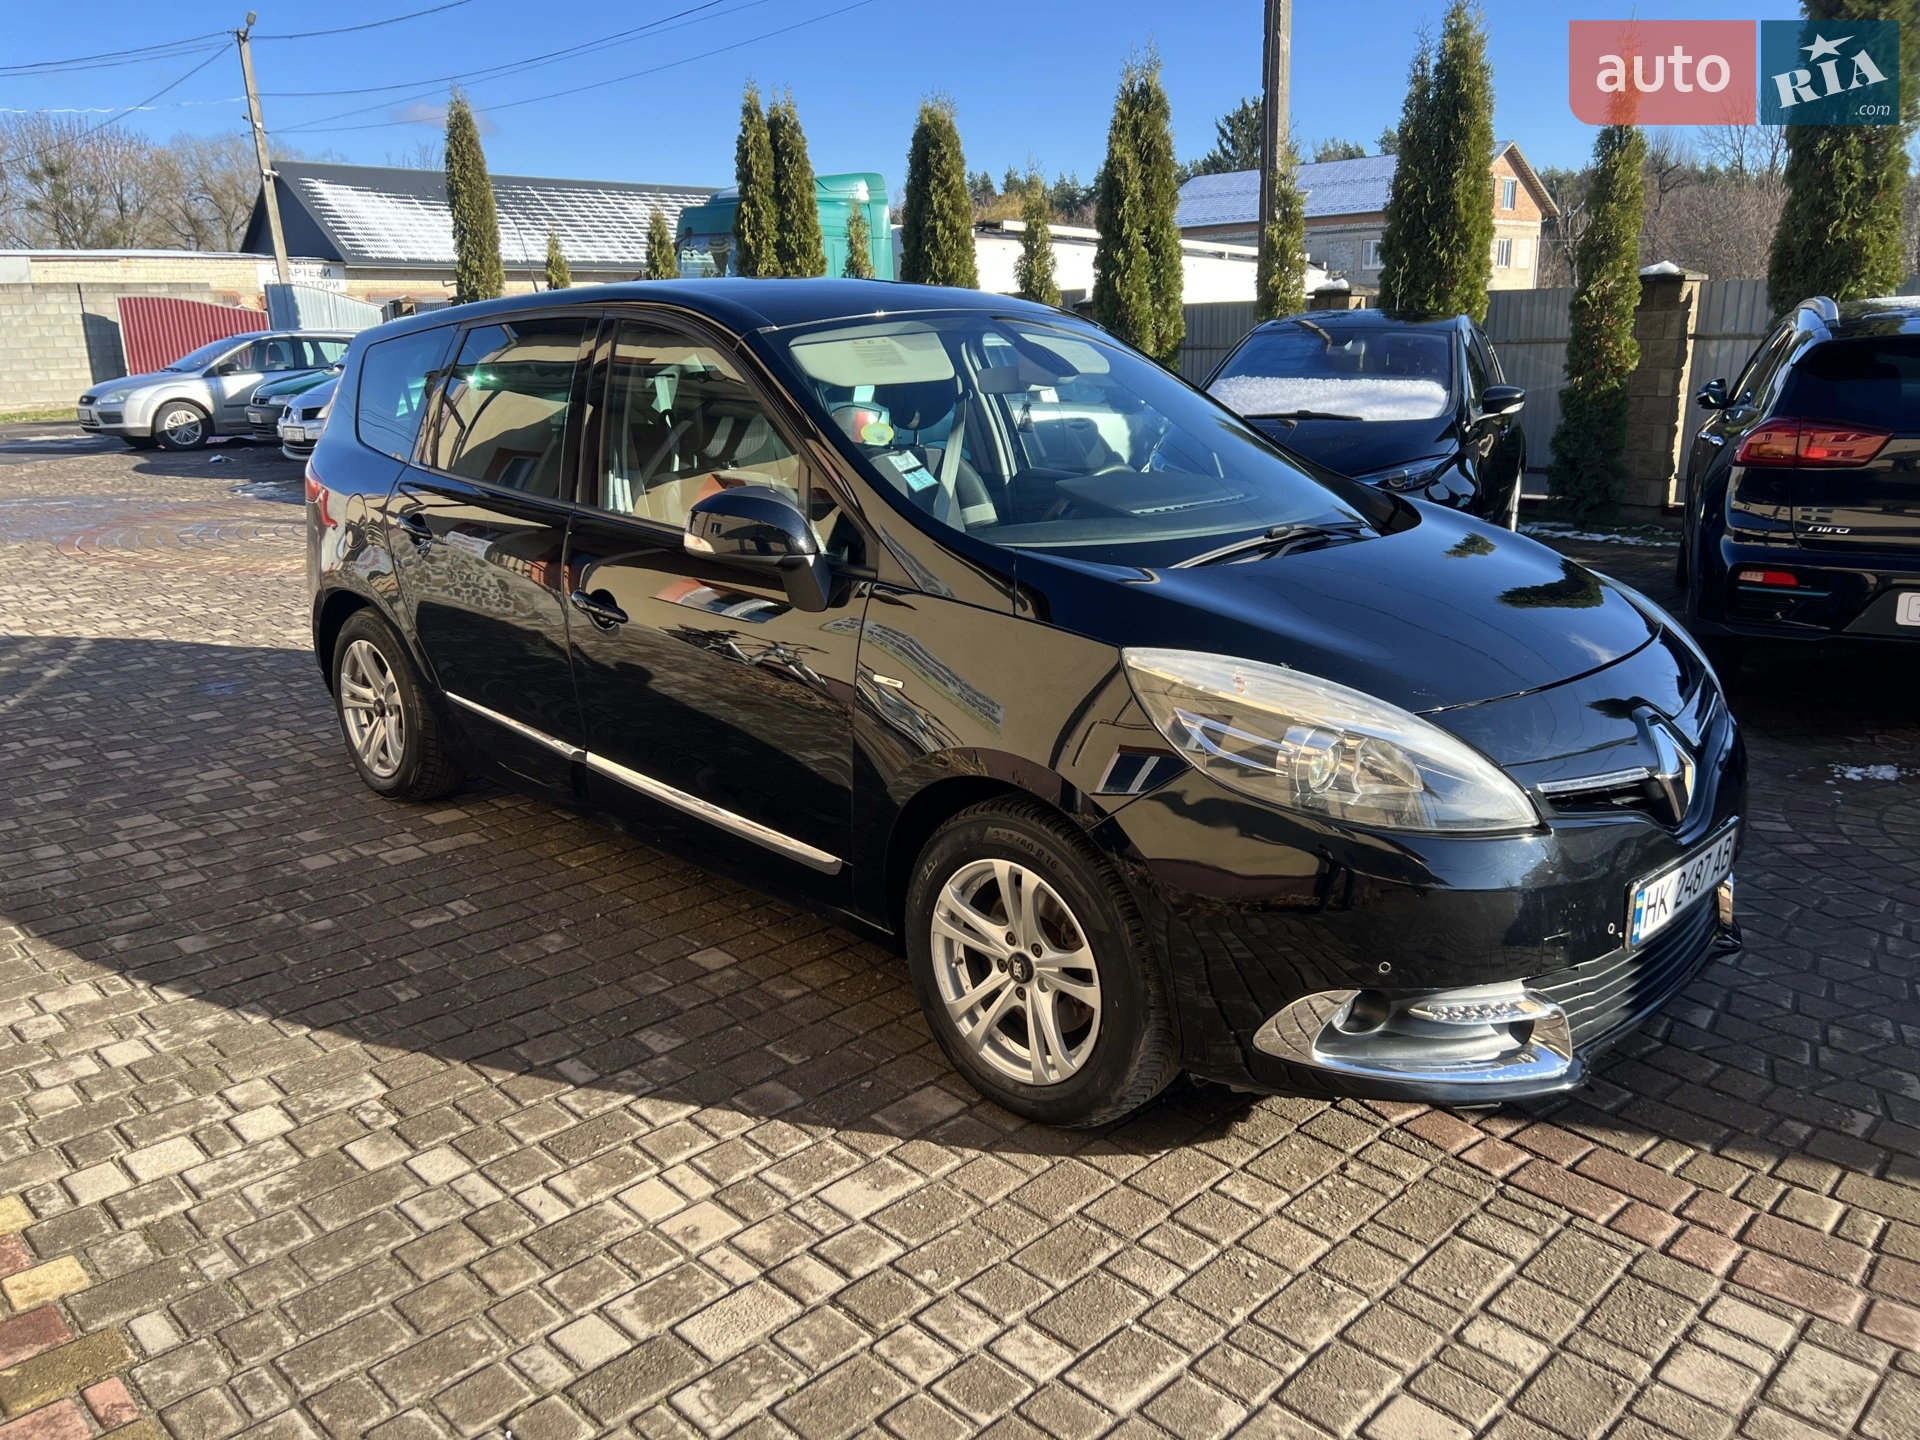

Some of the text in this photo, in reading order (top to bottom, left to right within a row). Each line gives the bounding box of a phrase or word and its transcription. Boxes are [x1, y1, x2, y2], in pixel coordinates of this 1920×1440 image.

[271, 267, 332, 278] САРТЕРИ
[1643, 836, 1732, 930] HK 2487 AB
